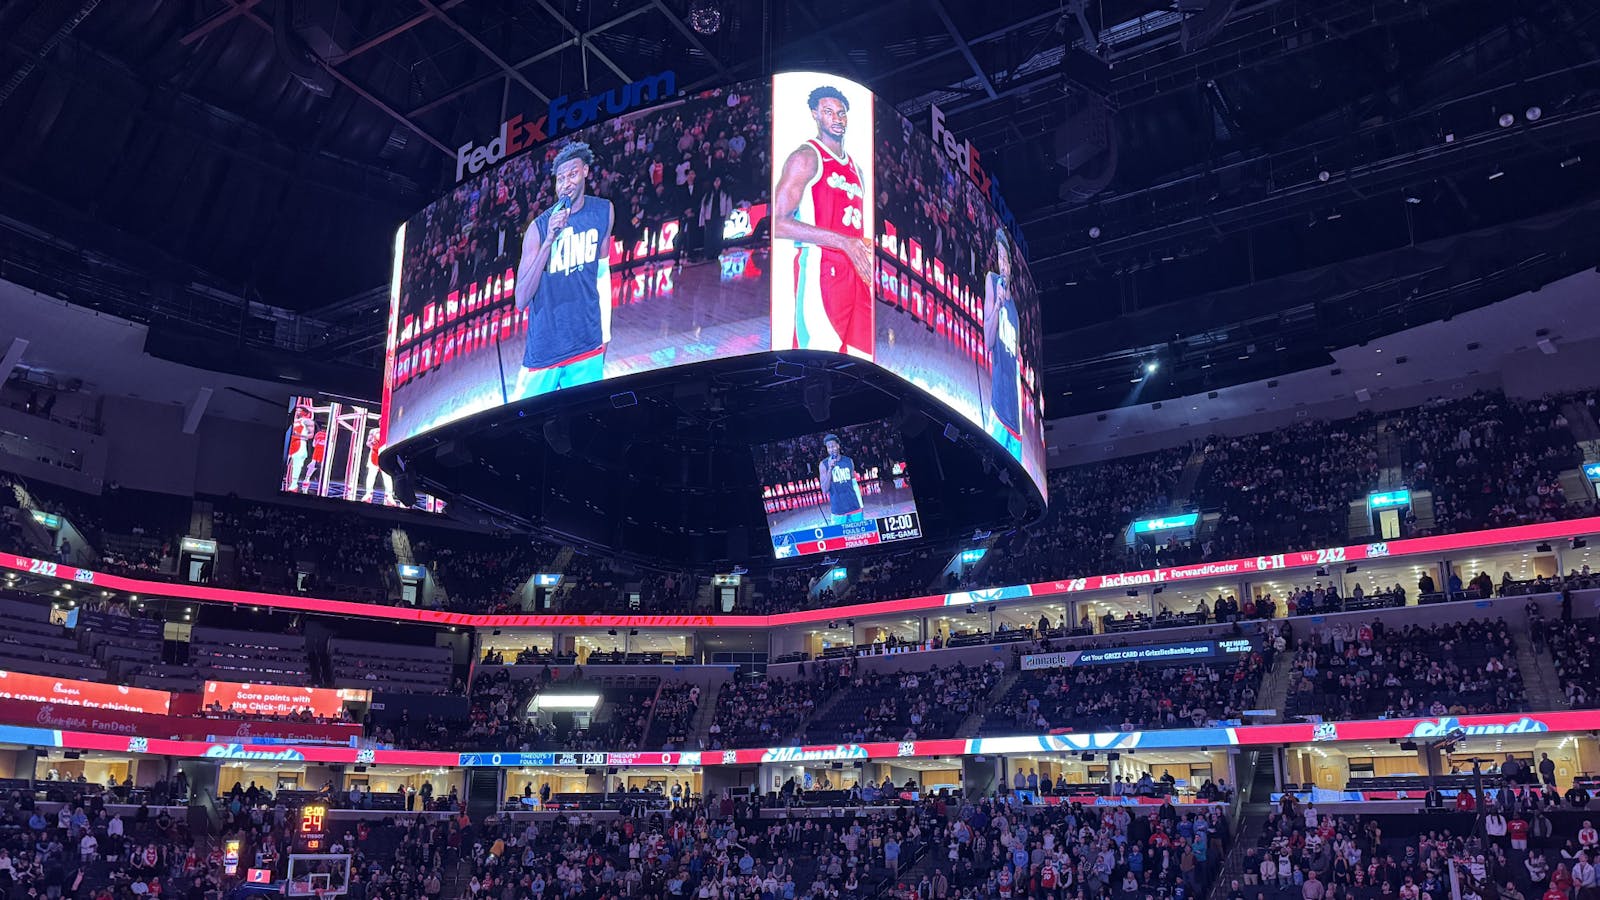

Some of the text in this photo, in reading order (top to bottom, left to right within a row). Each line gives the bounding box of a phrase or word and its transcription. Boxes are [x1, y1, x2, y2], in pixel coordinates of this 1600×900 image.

[455, 70, 676, 183] FedExForum
[550, 226, 599, 275] KING
[884, 514, 913, 532] 12:00
[815, 527, 824, 539] 0
[881, 528, 919, 541] PRE-GAME
[817, 540, 827, 551] 0
[30, 558, 57, 577] 242
[1099, 572, 1151, 588] Jackson
[1152, 569, 1169, 582] Jr.
[1171, 563, 1239, 578] Forward/Center
[1256, 554, 1285, 570] 6-11
[1301, 553, 1316, 562] Wt.
[1316, 547, 1346, 564] 242
[1103, 652, 1121, 660] GRIZZ
[1122, 650, 1138, 658] CARD
[1145, 646, 1208, 657] GrizzliesBanking.com
[237, 691, 311, 703] Score points with
[232, 701, 247, 709] the
[298, 705, 315, 713] Ap
[92, 719, 138, 733] FanDeck
[492, 753, 501, 765] 0
[582, 753, 604, 764] 12:00
[661, 753, 671, 764] 0
[761, 744, 867, 762] Memphis
[304, 806, 325, 817] 12:00
[302, 815, 322, 832] 24
